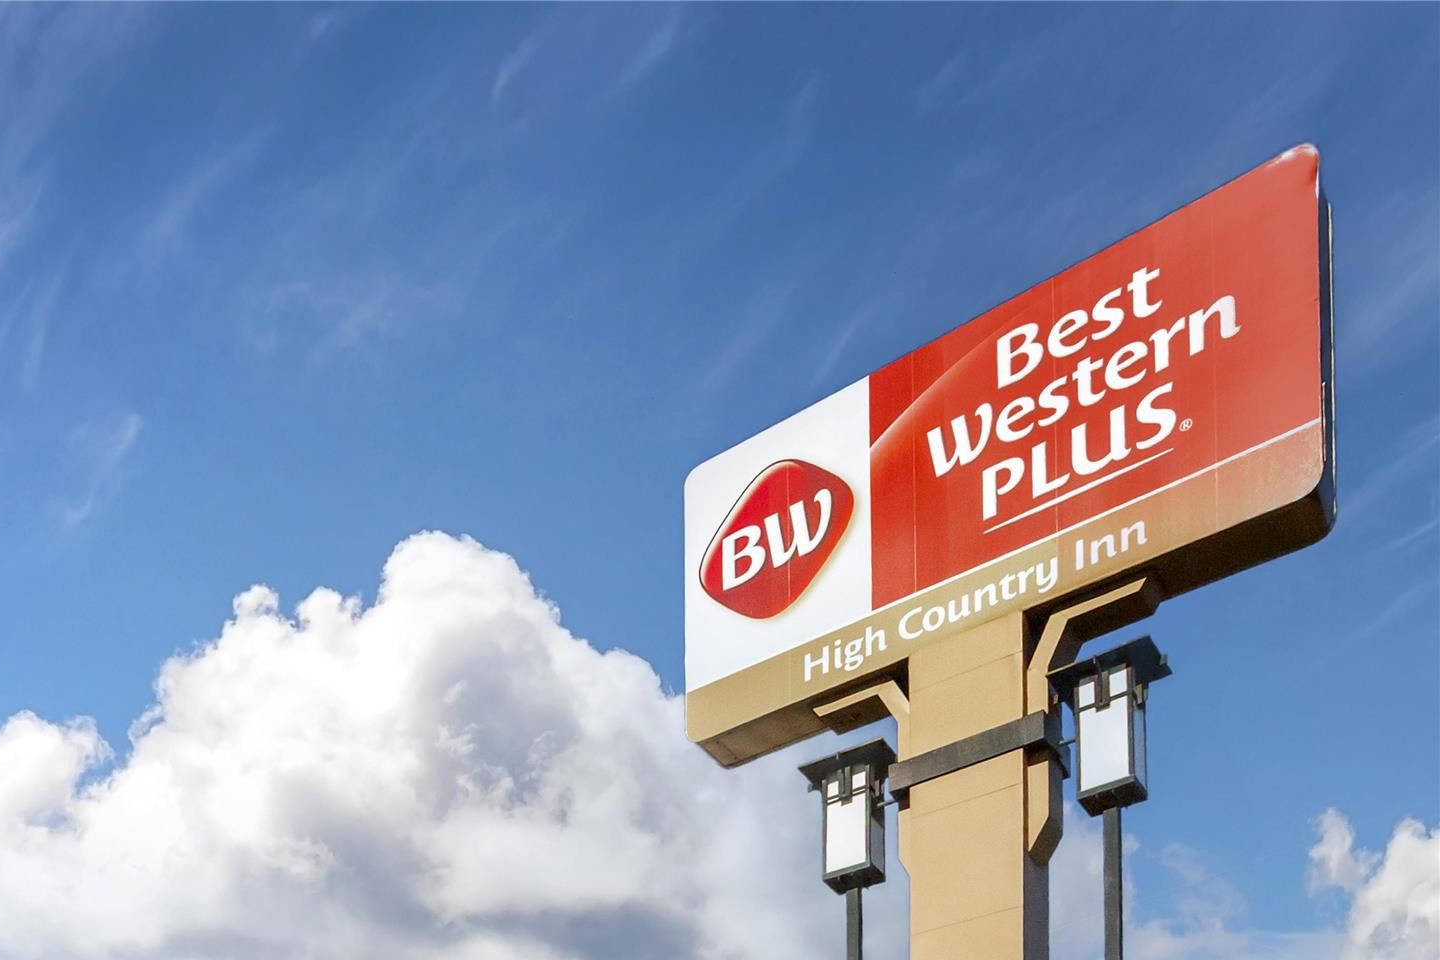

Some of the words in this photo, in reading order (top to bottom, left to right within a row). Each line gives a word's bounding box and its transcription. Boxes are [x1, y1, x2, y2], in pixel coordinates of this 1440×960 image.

[926, 294, 1241, 477] Western
[995, 266, 1162, 389] Best
[982, 381, 1177, 521] PLUS
[722, 488, 832, 590] BW
[803, 627, 886, 682] High
[897, 554, 1058, 641] Country
[1074, 518, 1148, 571] Inn
